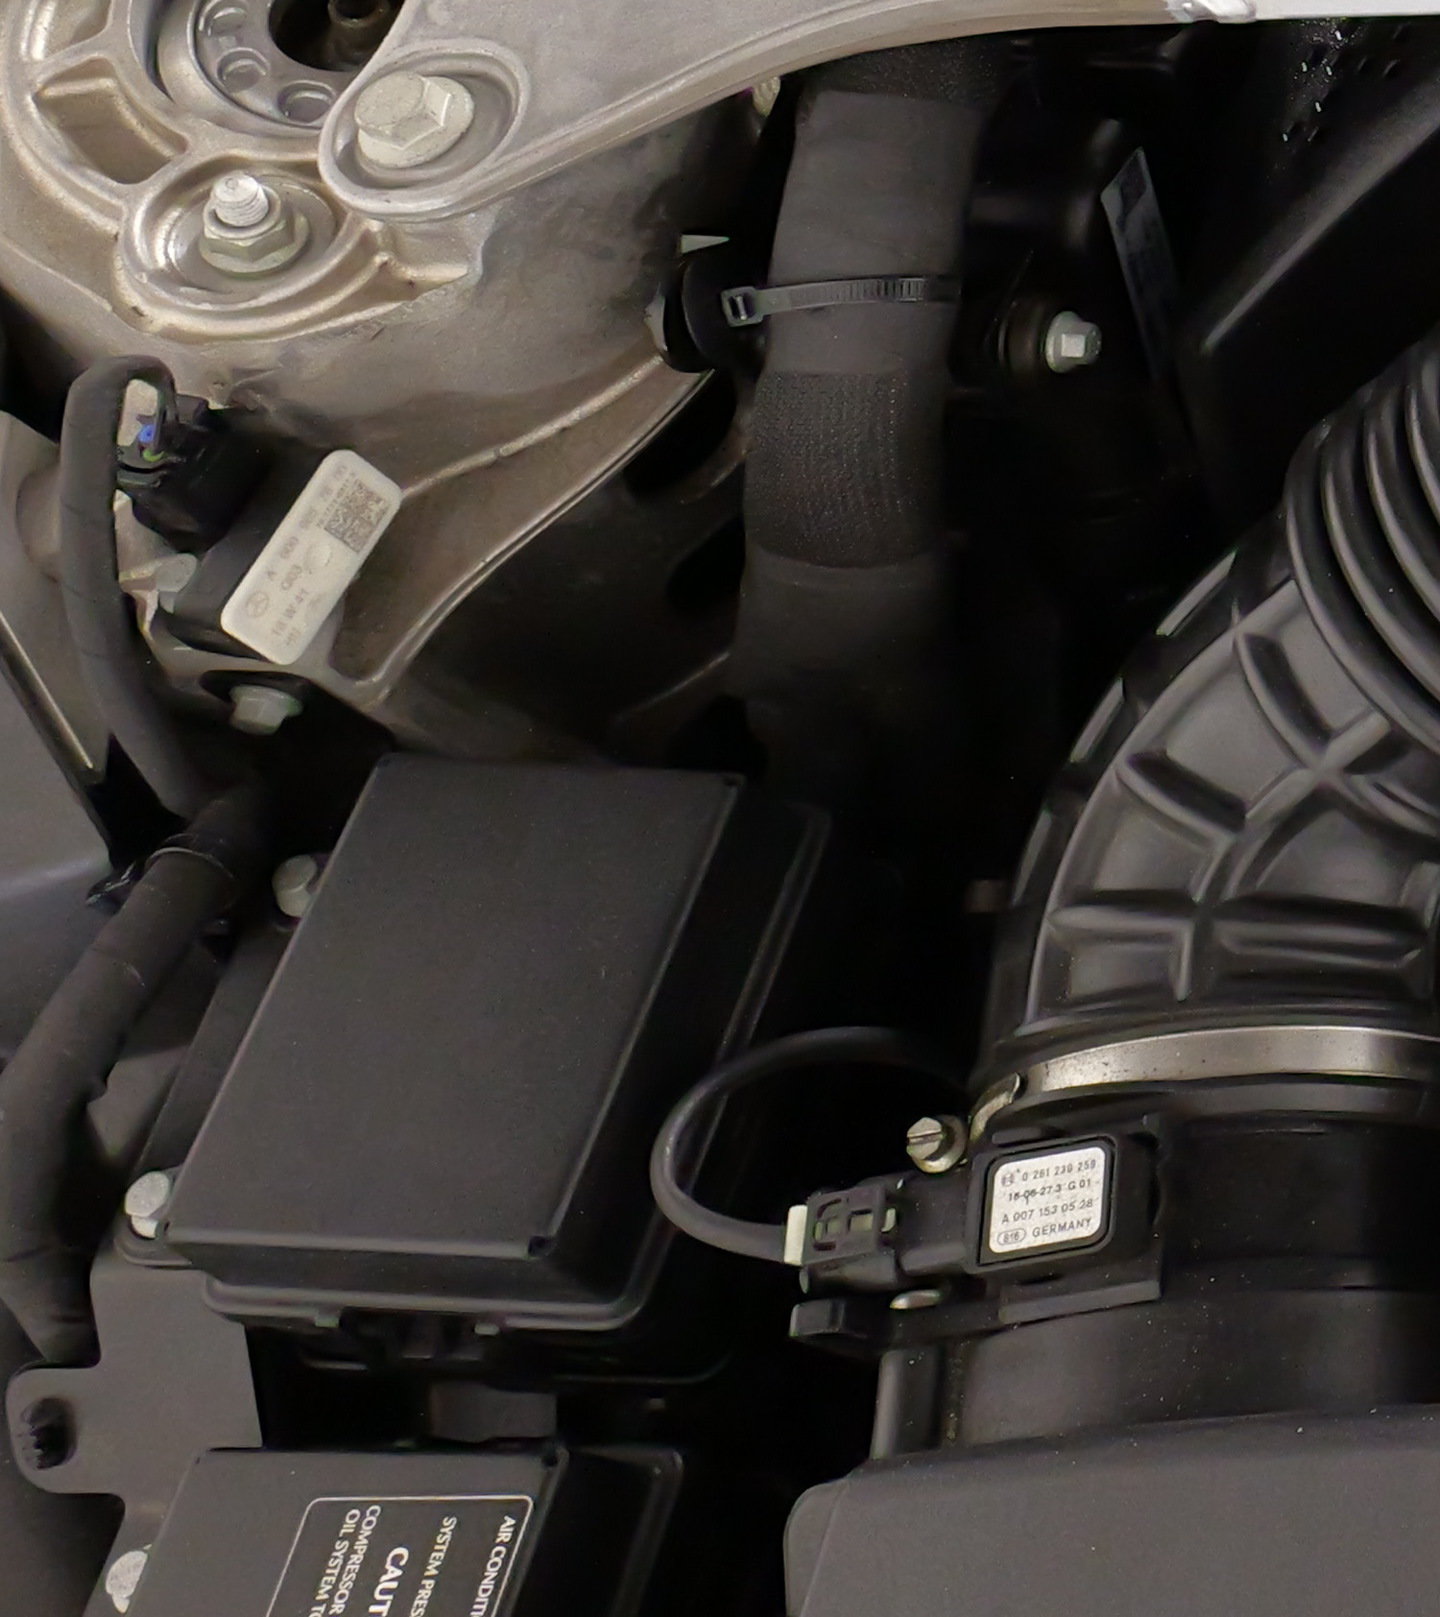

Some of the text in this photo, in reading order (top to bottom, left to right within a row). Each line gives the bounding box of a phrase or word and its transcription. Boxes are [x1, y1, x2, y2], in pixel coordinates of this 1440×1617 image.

[1022, 1172, 1028, 1181] 0
[1002, 1199, 1093, 1224] A 007 153 05 28
[1032, 1218, 1092, 1237] GERMANY
[338, 1509, 361, 1537] OIL
[423, 1516, 457, 1577] SYSTEM
[315, 1539, 350, 1601] SYSTEM
[329, 1504, 381, 1616] COMPRESSOR
[368, 1547, 409, 1617] CAUT
[469, 1515, 517, 1617] AIR CONDITI
